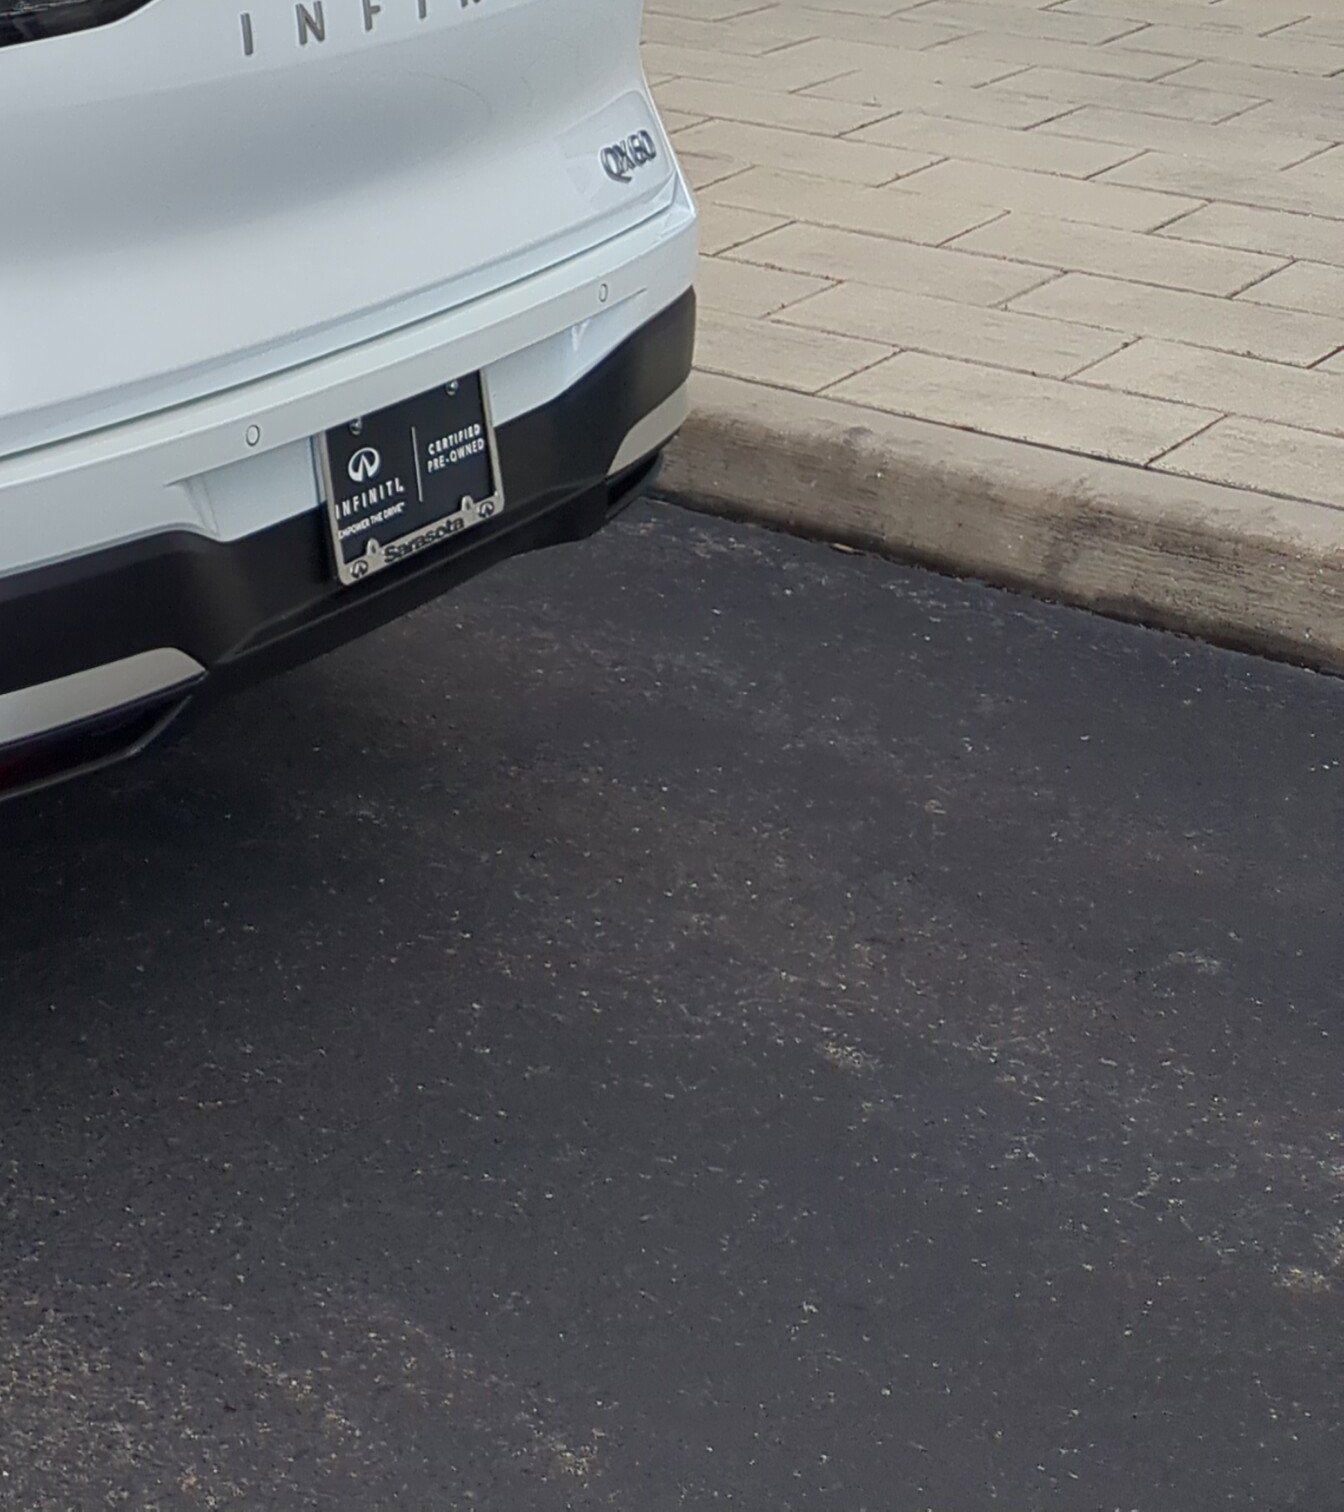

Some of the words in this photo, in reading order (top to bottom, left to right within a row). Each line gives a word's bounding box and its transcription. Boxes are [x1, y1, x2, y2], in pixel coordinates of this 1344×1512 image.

[600, 129, 657, 184] QX60
[427, 438, 484, 473] PRE-OWNED
[428, 423, 481, 455] CERTIFIED
[334, 477, 401, 519] INFINITI
[337, 517, 370, 540] EMPOWER
[370, 511, 383, 525] THE
[384, 517, 464, 563] Sarasota
